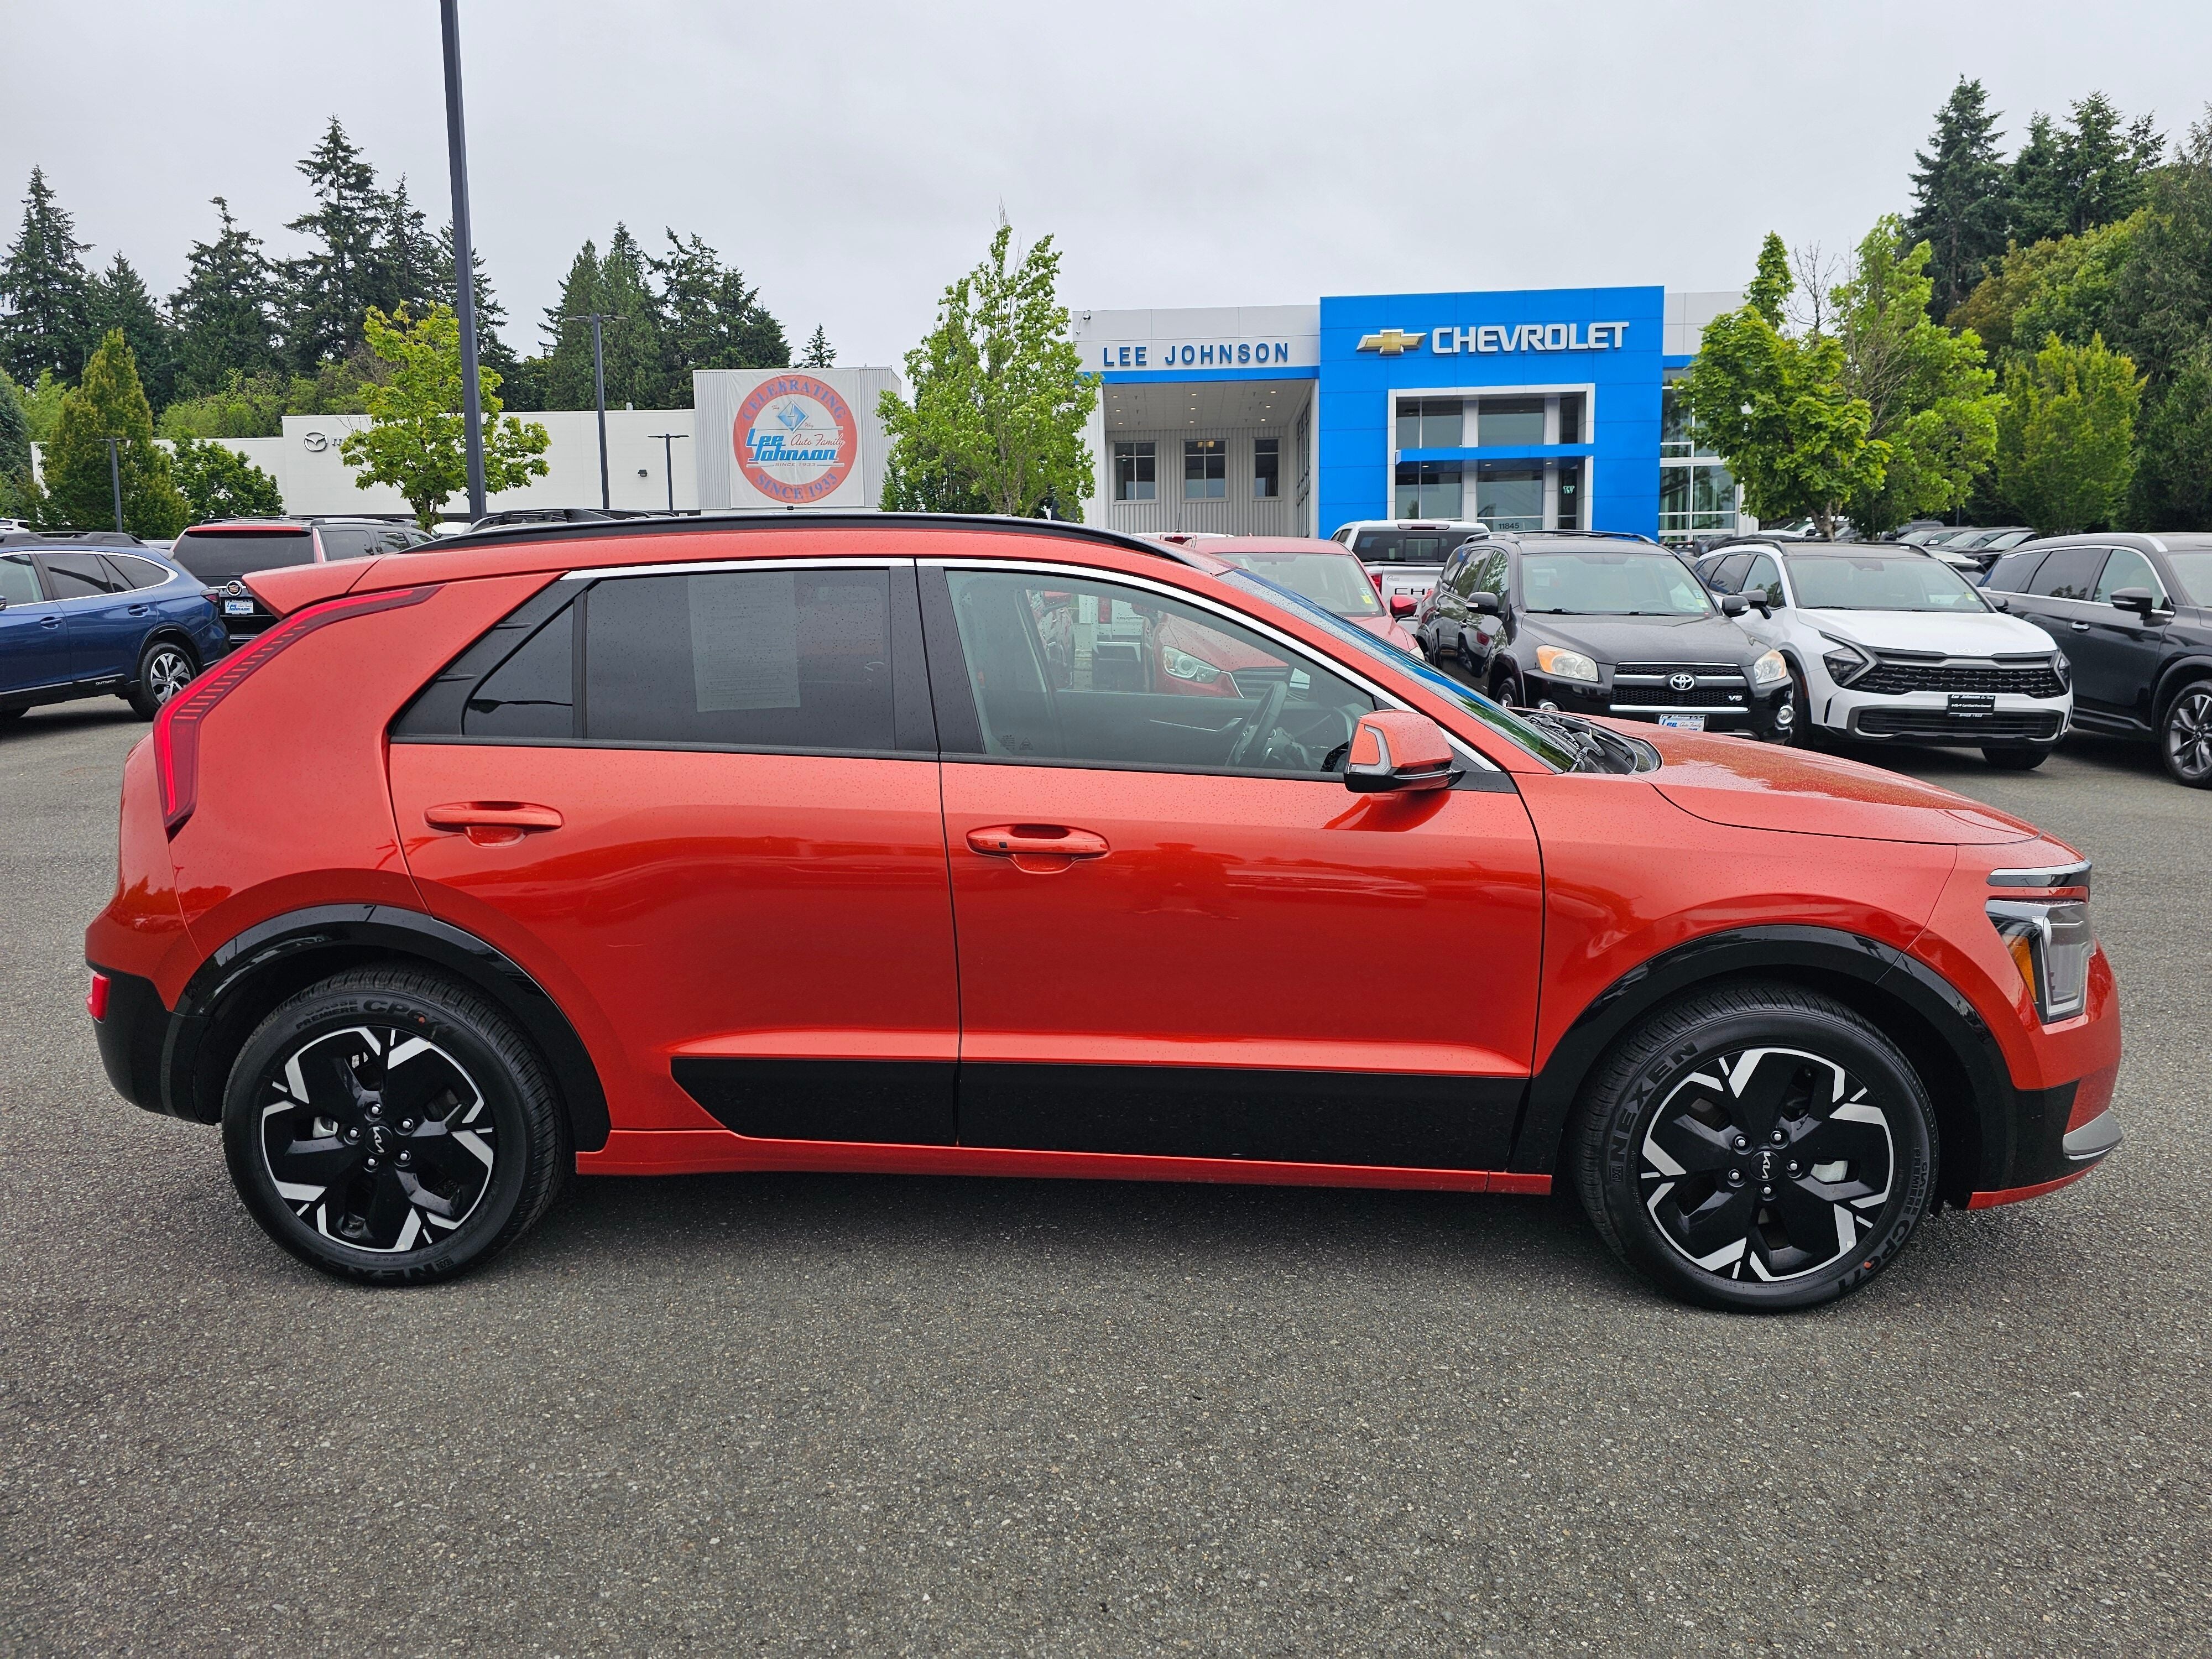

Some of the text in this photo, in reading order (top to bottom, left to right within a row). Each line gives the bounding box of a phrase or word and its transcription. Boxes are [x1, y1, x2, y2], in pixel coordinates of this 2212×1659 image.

[1104, 343, 1288, 366] LEE JOHNSON
[1432, 321, 1630, 354] CHEVROLET
[743, 379, 847, 420] CELEBRATING
[746, 428, 846, 450] Lee Auto Family
[748, 443, 838, 461] Johnson
[756, 472, 838, 499] SINCE 1933
[295, 999, 460, 1037] PREMIERE CP671
[1610, 1040, 1699, 1162] NEXEN
[1903, 1147, 1921, 1215] PREMIERE
[1911, 1161, 1928, 1215] CLASSE
[1838, 1219, 1911, 1293] CP671
